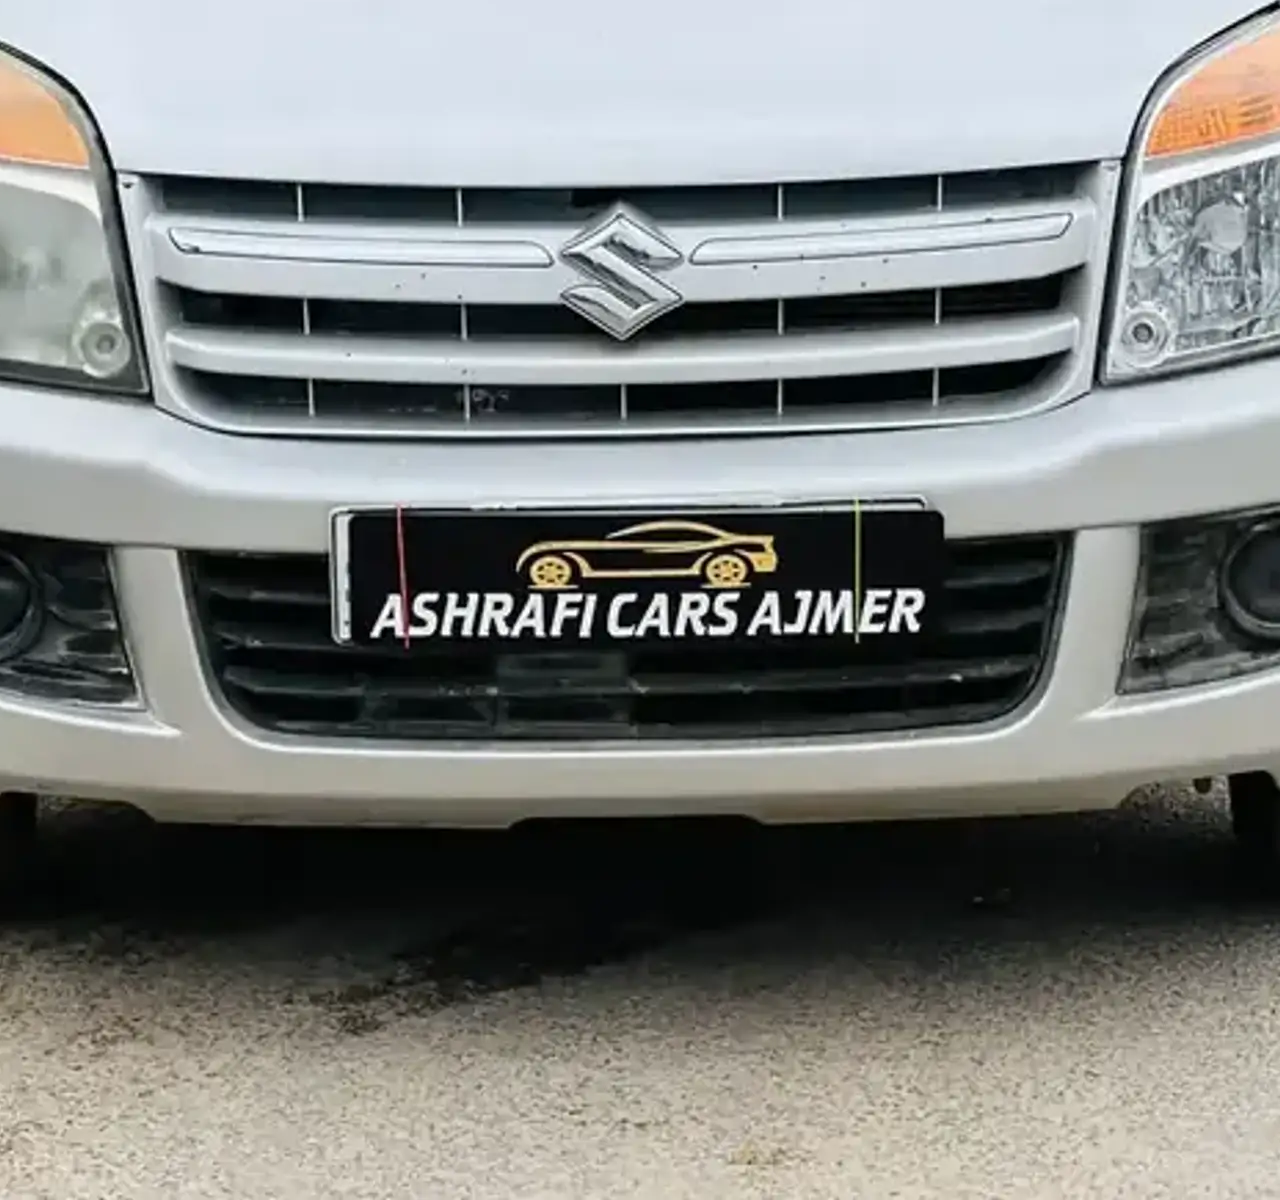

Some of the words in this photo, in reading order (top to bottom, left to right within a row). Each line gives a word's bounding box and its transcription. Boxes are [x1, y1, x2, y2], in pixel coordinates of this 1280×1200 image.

[371, 592, 595, 638] ASHRAFI
[607, 591, 738, 636] CARS
[747, 588, 925, 635] AJMER
